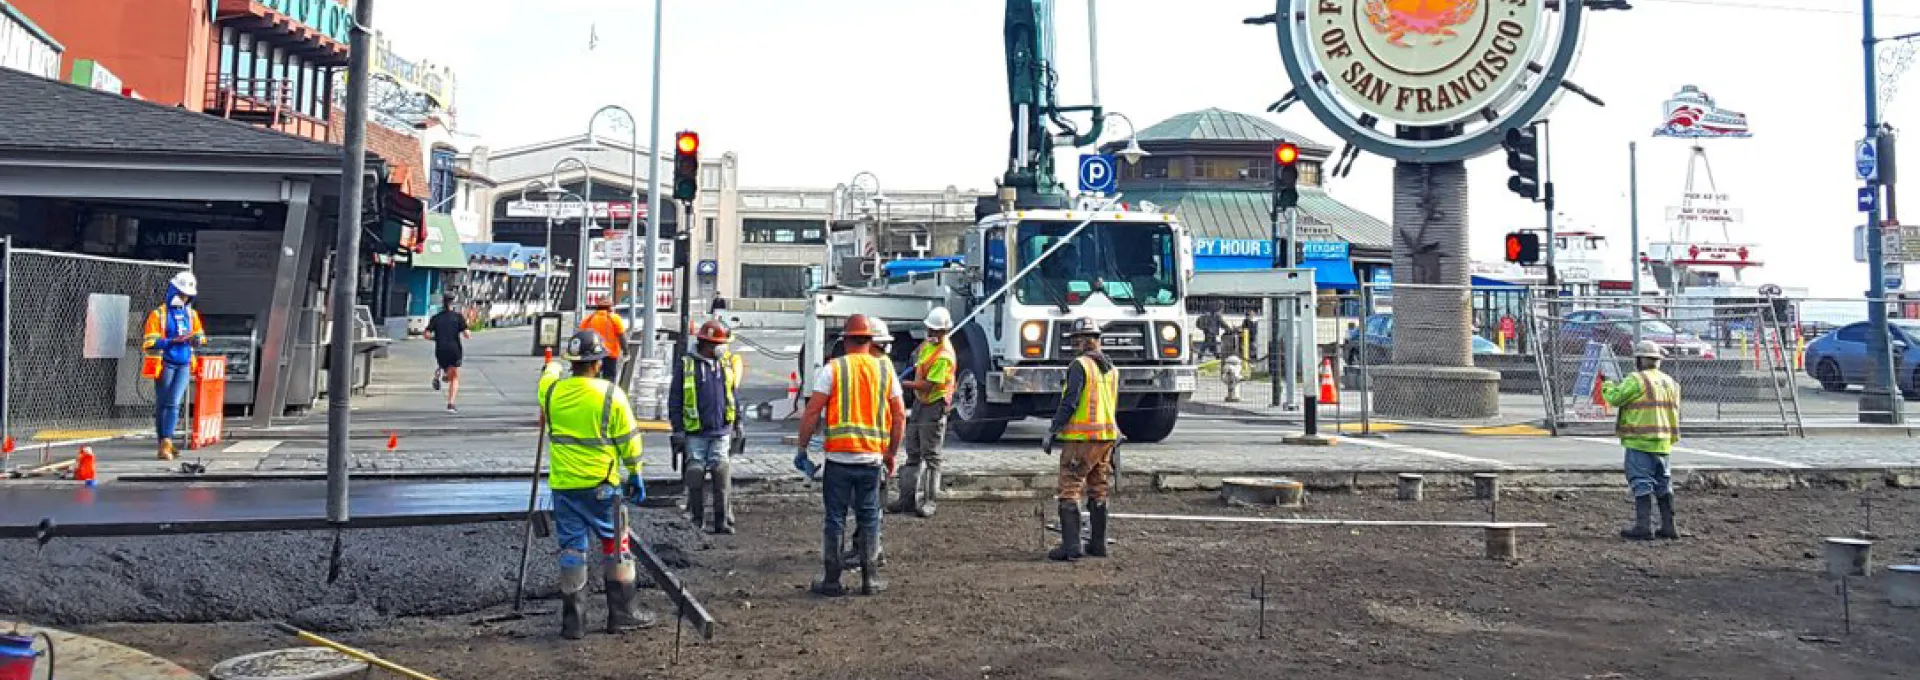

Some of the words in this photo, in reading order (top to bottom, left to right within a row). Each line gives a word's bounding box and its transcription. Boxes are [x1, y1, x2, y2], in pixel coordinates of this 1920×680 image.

[1321, 28, 1352, 59] OF
[1341, 61, 1393, 106] SAN
[1395, 19, 1524, 113] FRANCISCO
[1090, 162, 1104, 184] P
[1194, 239, 1214, 255] PY
[1220, 239, 1260, 256] HOUR
